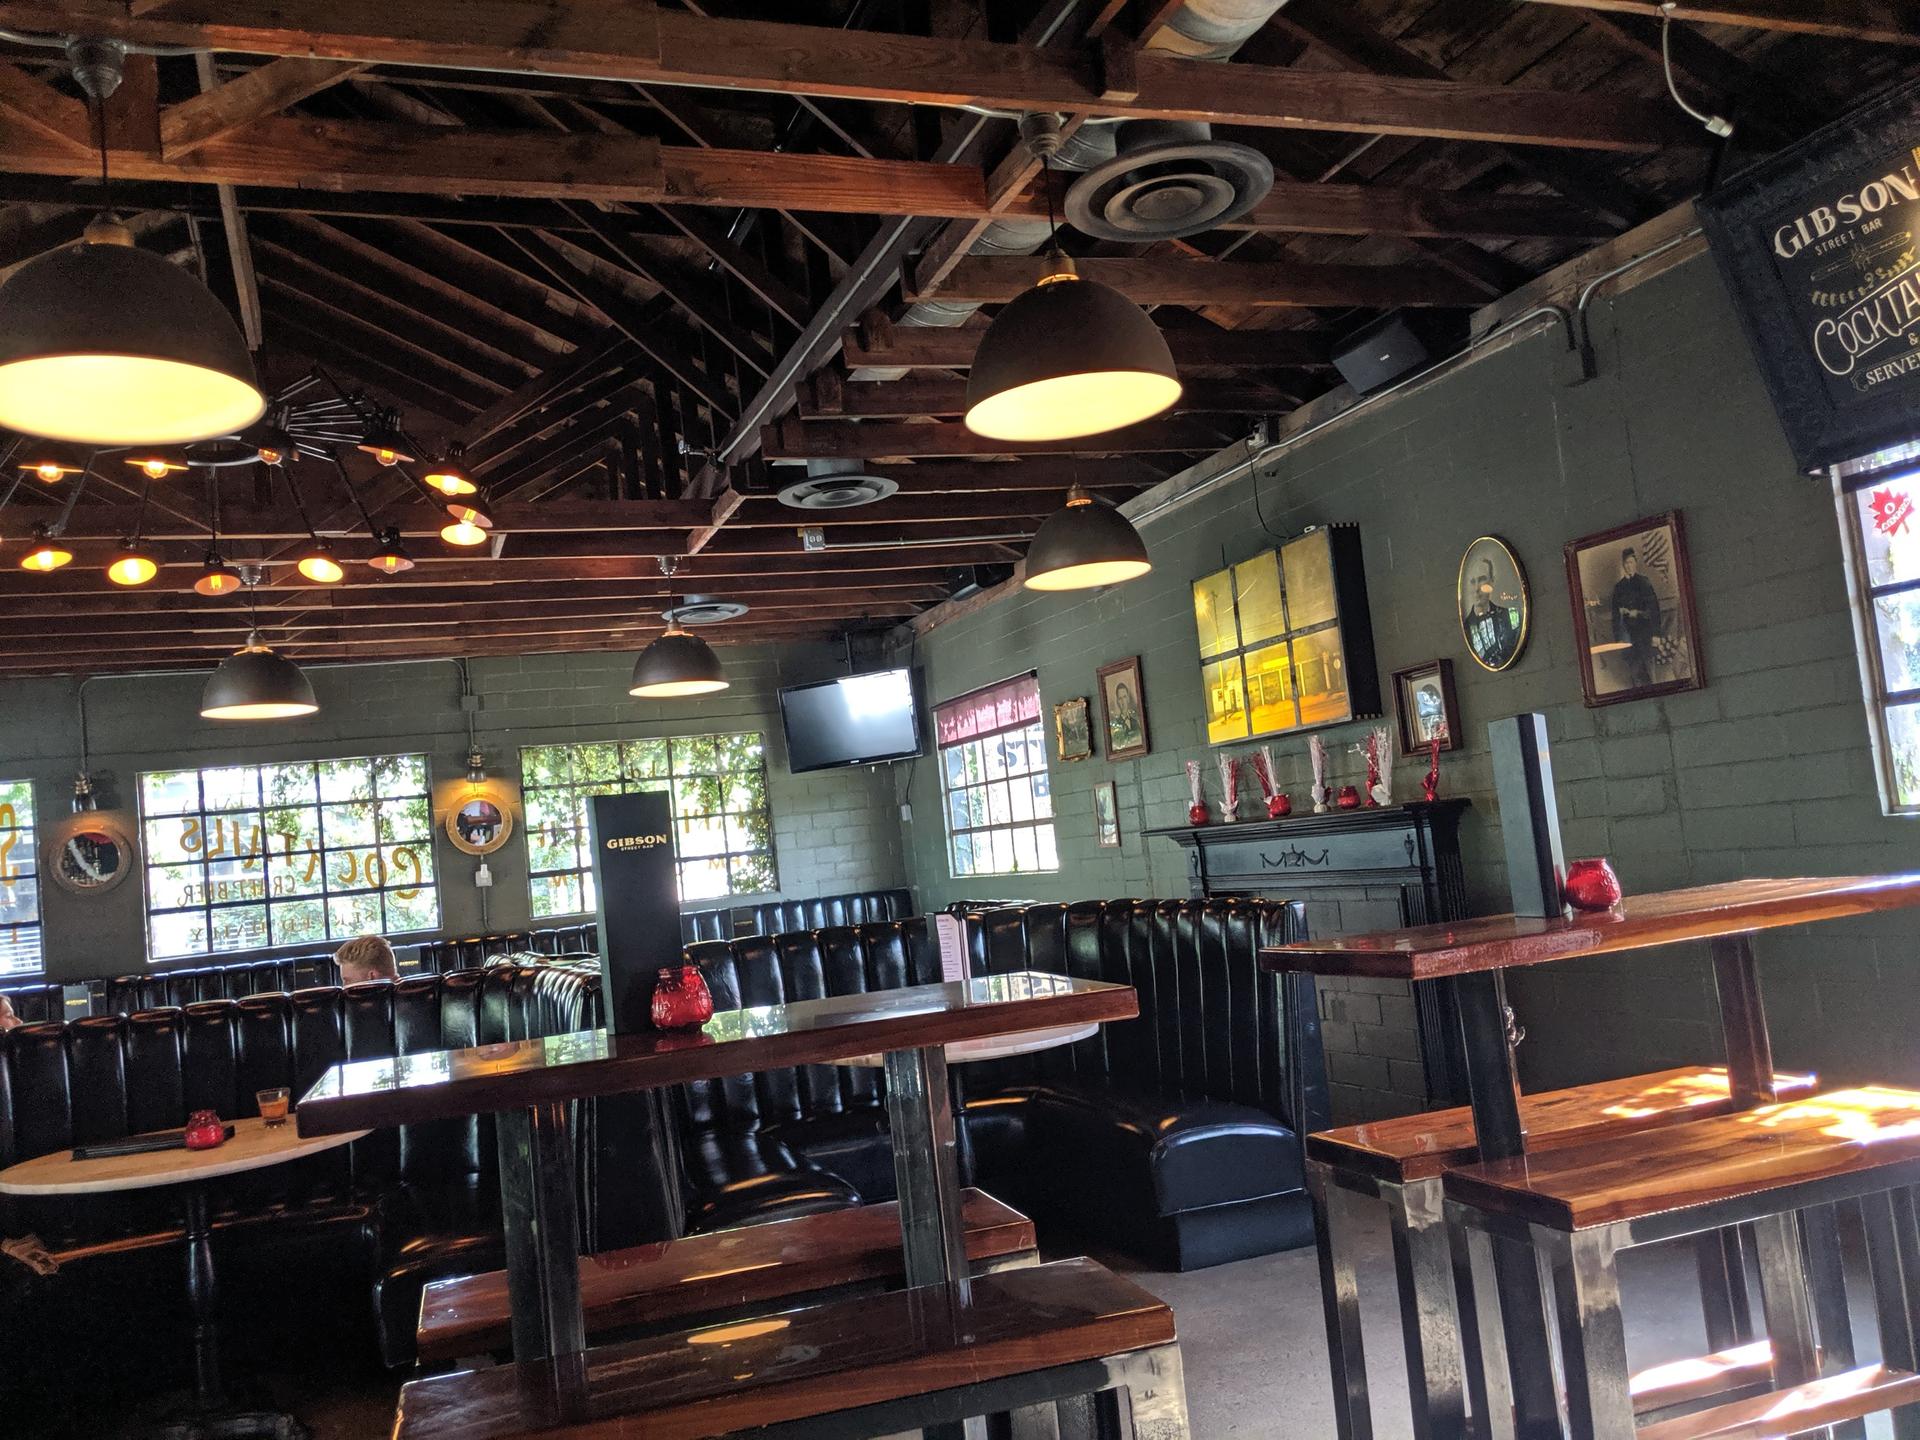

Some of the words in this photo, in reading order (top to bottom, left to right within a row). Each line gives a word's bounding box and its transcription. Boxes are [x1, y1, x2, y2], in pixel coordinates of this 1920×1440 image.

[1774, 166, 1920, 258] GIBSON
[1814, 230, 1856, 256] STREET
[1861, 217, 1883, 235] BAR
[1908, 332, 1919, 345] &
[1866, 352, 1920, 385] SERVE
[606, 834, 667, 849] GIBSON
